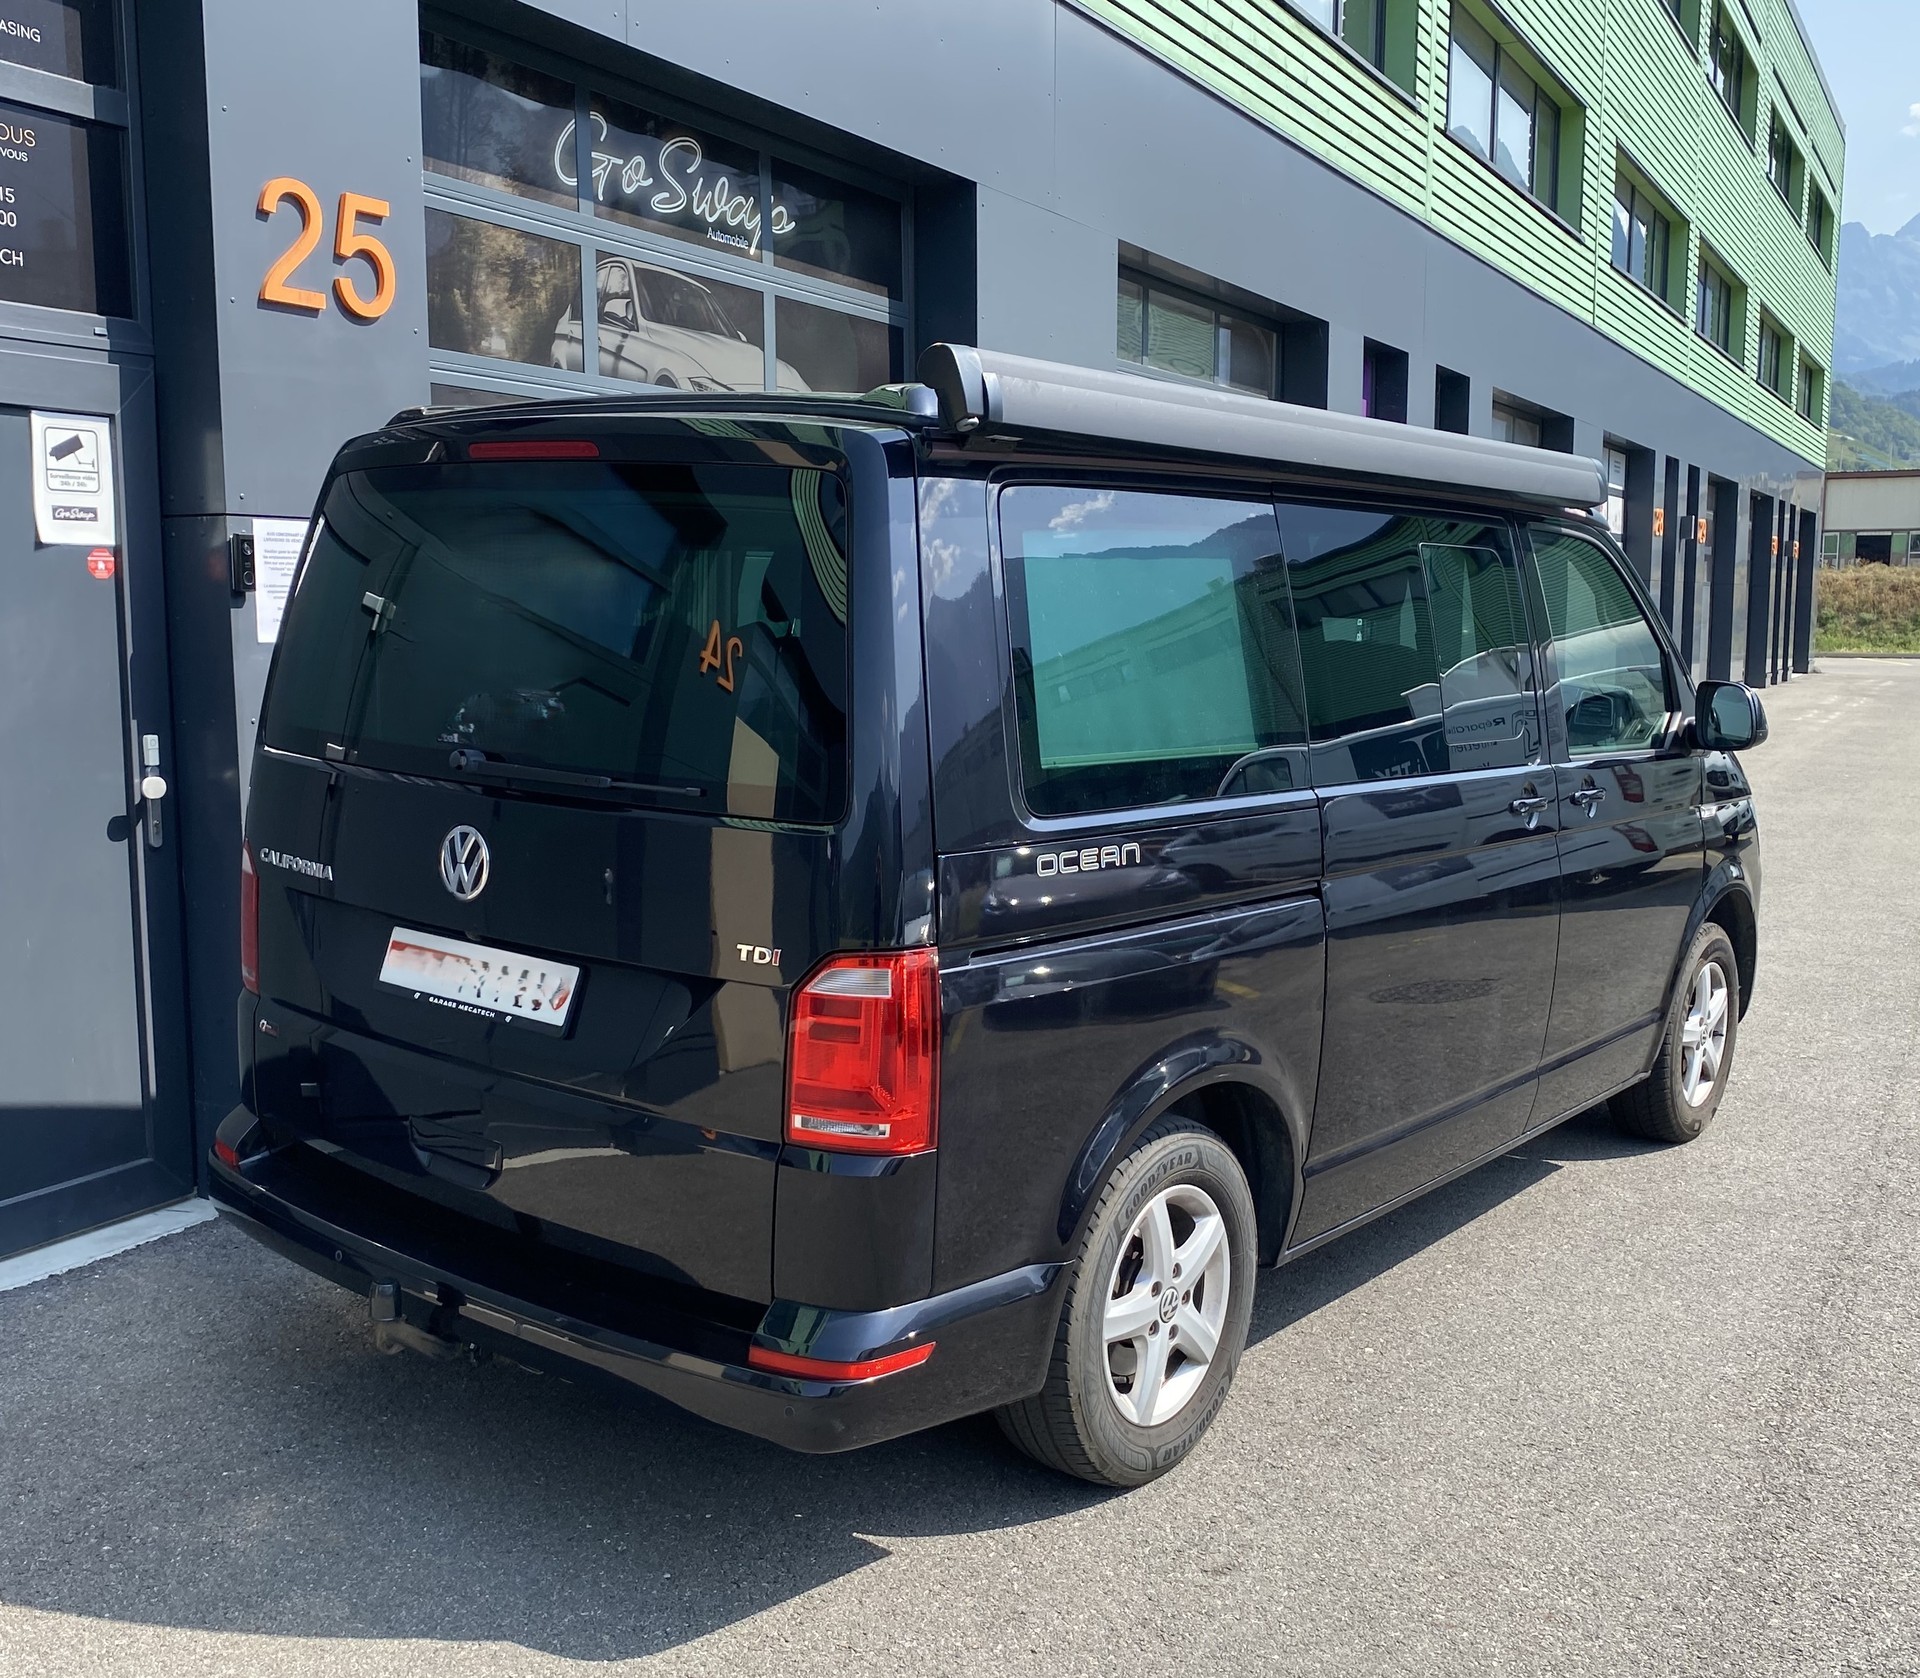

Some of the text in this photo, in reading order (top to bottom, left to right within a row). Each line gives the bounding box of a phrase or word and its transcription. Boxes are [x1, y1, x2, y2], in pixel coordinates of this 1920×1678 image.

[257, 177, 396, 318] 25
[707, 227, 749, 249] Automobile
[259, 848, 334, 881] CALIFORNIA
[1036, 842, 1140, 877] OCEAN
[736, 943, 782, 967] TDI
[428, 996, 496, 1018] GARAGE MECATECH
